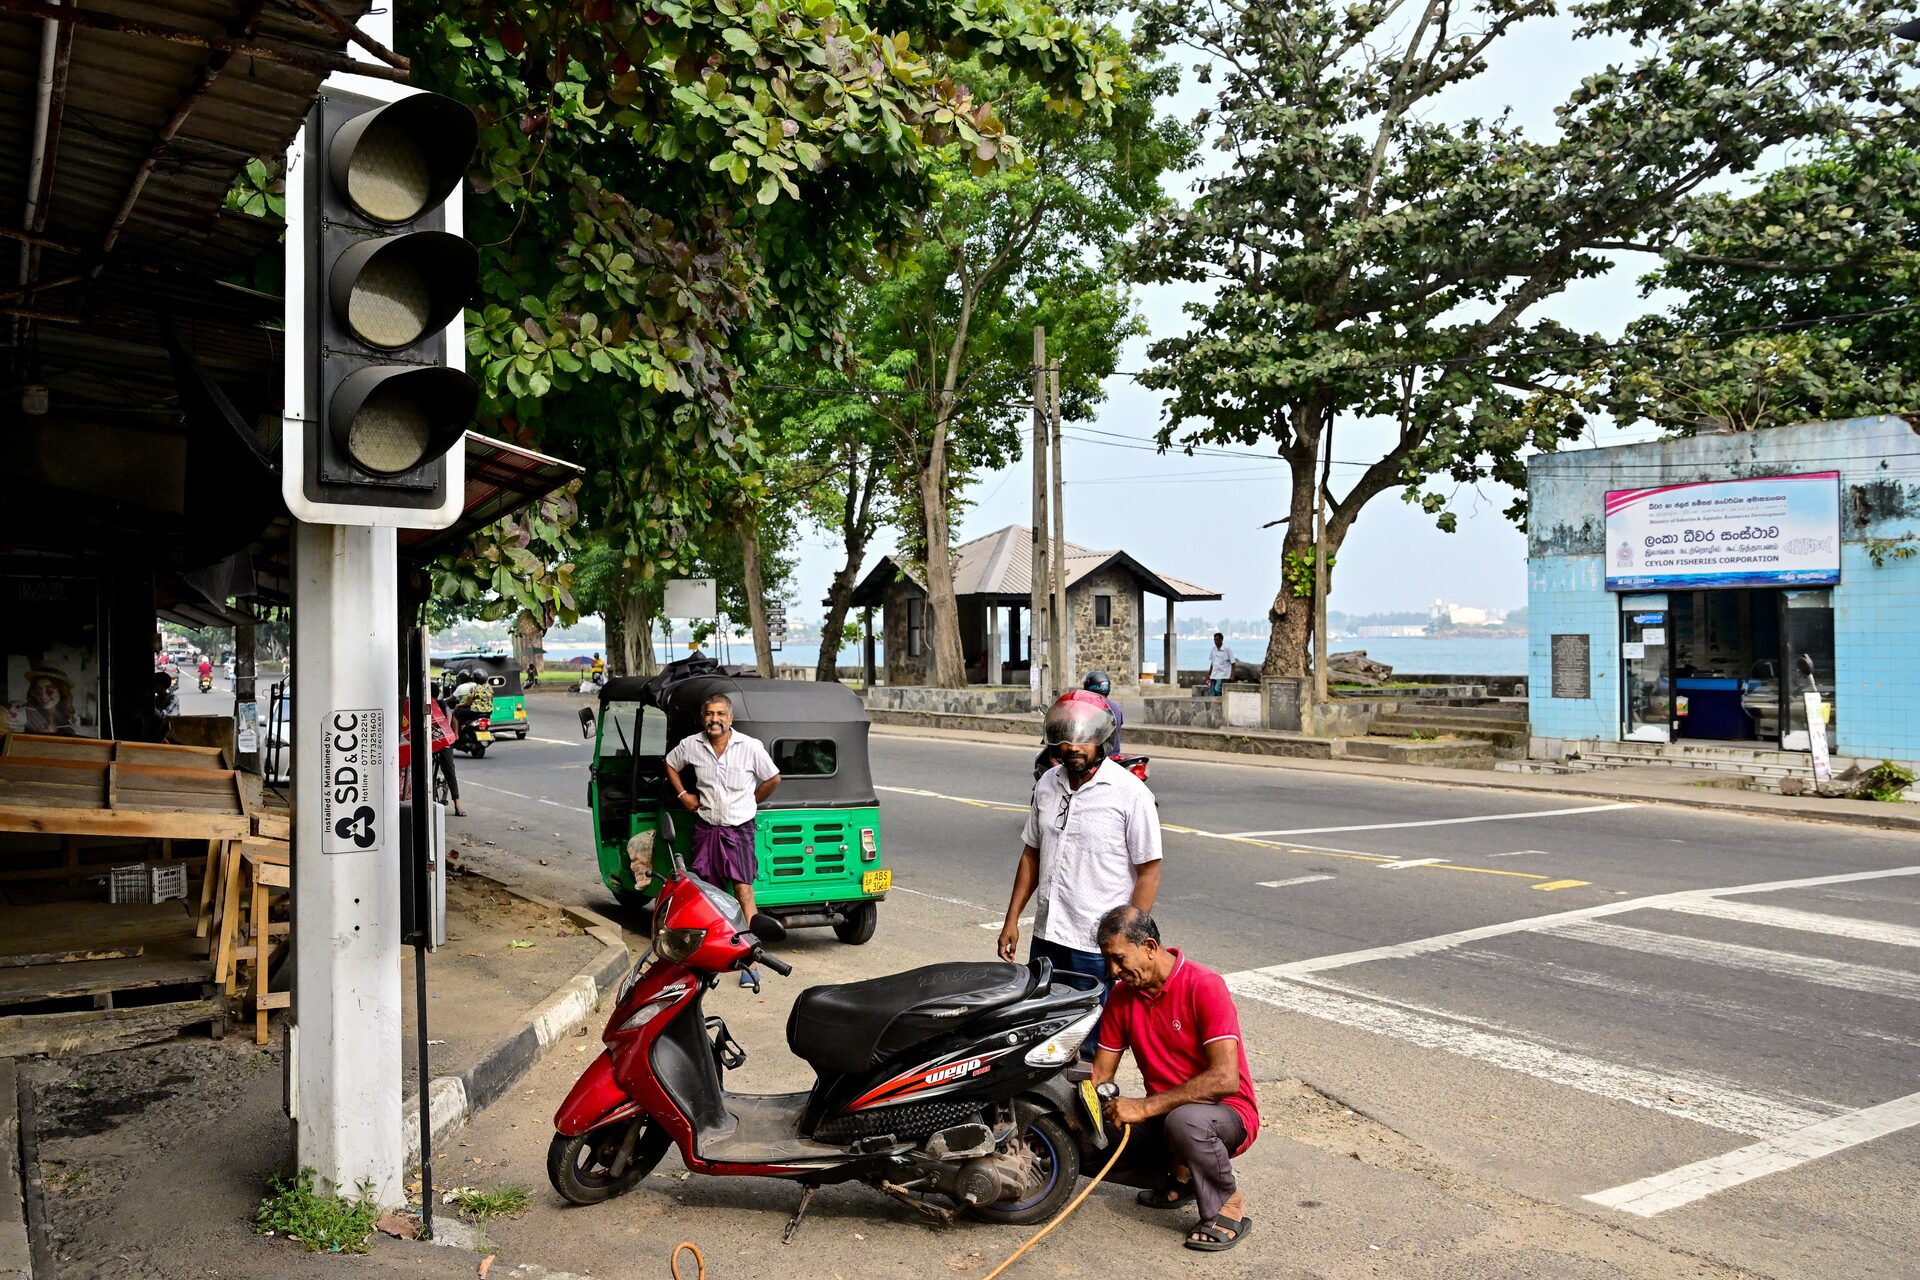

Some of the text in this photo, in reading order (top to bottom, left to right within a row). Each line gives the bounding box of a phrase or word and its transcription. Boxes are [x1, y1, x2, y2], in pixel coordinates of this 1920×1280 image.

[1645, 525, 1780, 547] ලංකා ධීවර සංස්ථාව
[1645, 555, 1780, 567] CEYLON FISHERIES CORPORATION
[324, 731, 333, 742] by
[874, 871, 888, 881] ABS
[865, 879, 873, 887] SP
[924, 1058, 982, 1084] wego
